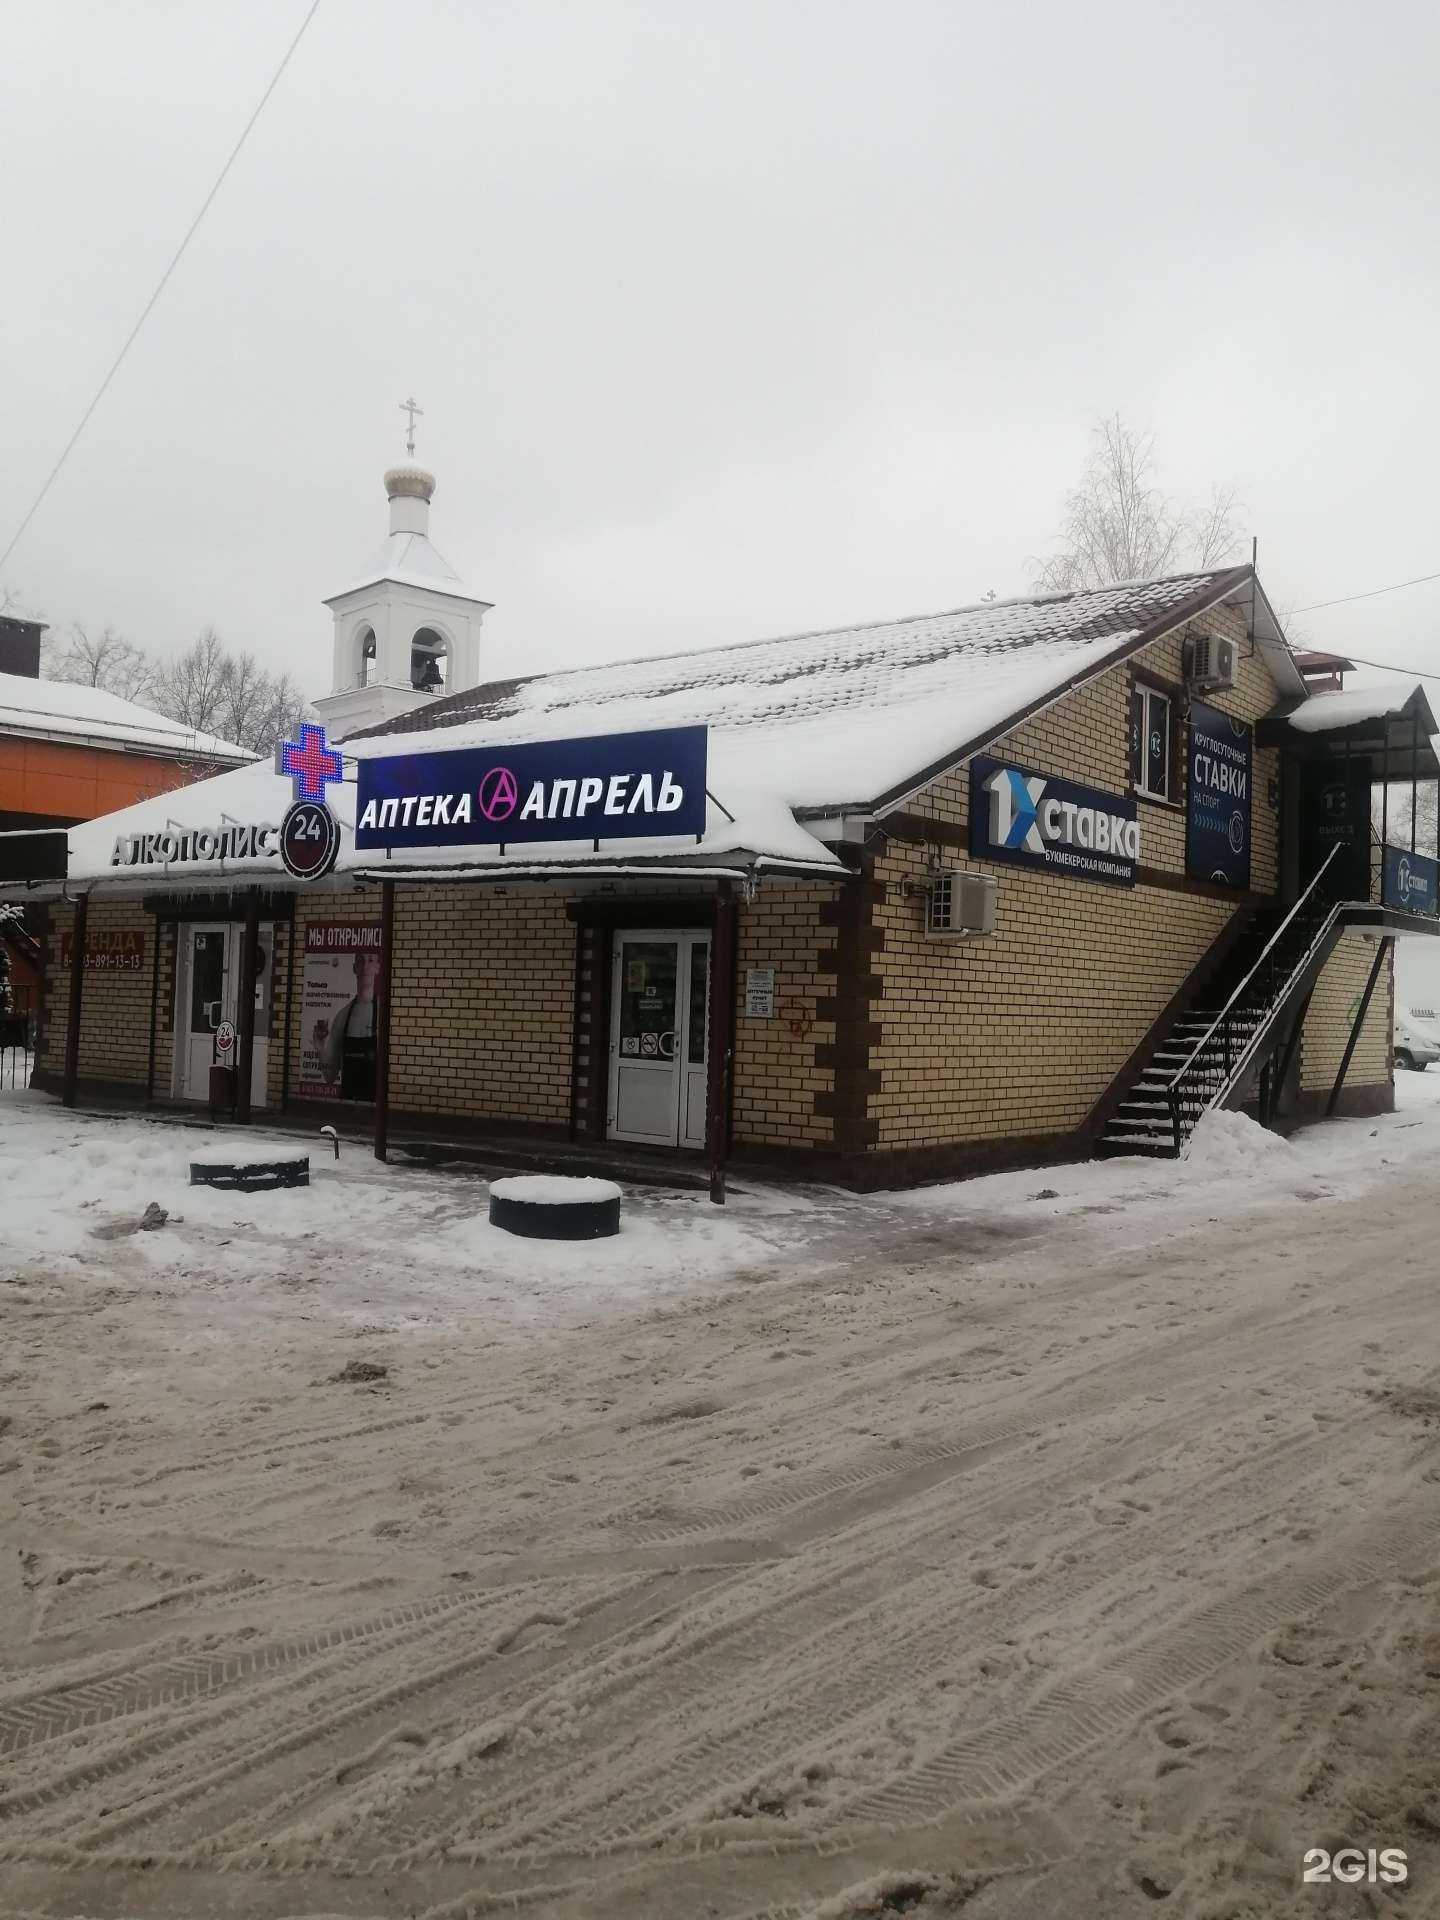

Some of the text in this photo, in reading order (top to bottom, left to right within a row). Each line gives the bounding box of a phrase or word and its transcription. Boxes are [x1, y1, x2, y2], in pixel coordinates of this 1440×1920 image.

[1194, 732, 1247, 766] КРУГЛОСУТОЧНЫЕ
[1194, 753, 1247, 800] СТАВКИ
[358, 793, 472, 829] АПТЕКА
[519, 770, 684, 820] АПРЕЛЬ
[1193, 791, 1221, 810] НА СПОРТ
[294, 814, 321, 841] 24
[111, 821, 280, 866] АЛКОПОЛИС
[1044, 850, 1132, 878] БУКМЕКЕРСКАЯ КОМПАНИЯ
[308, 927, 325, 947] МЫ
[220, 1027, 230, 1038] 24
